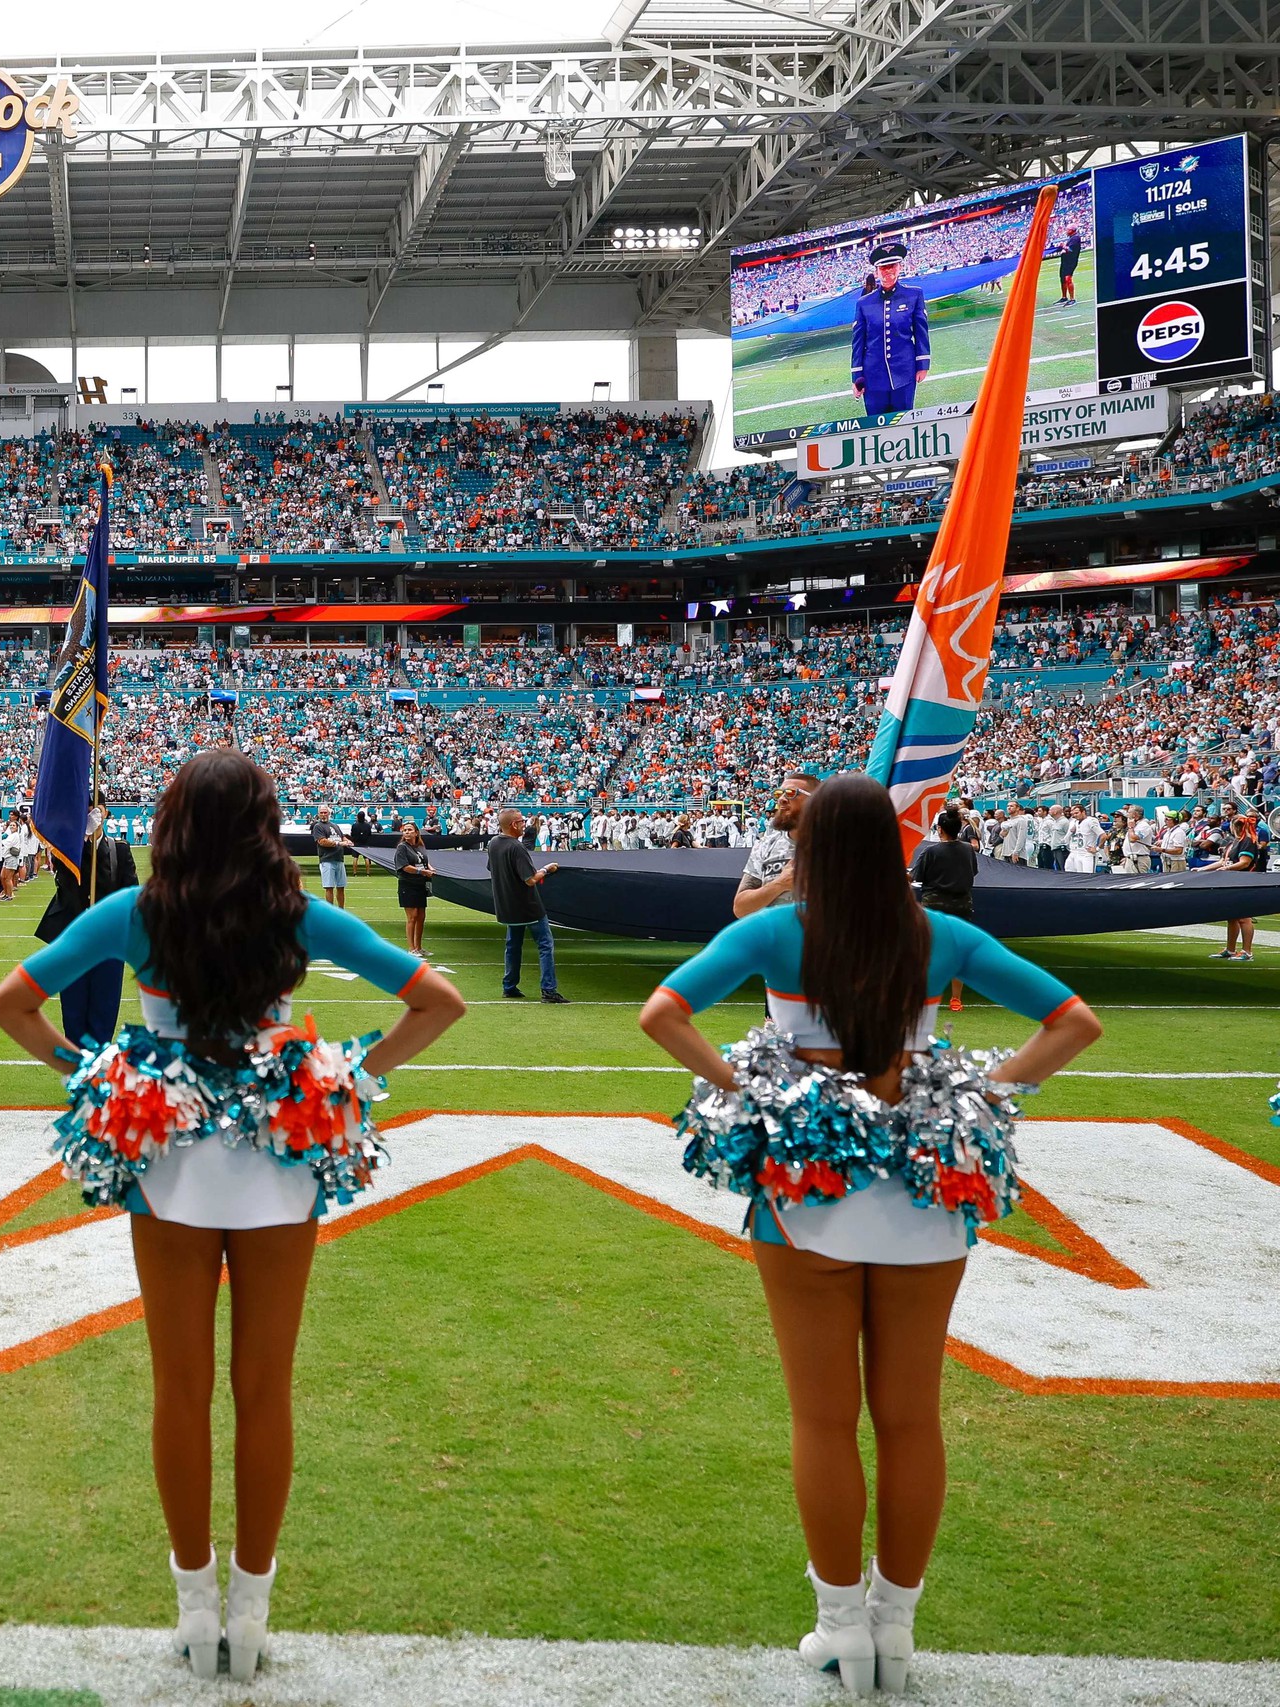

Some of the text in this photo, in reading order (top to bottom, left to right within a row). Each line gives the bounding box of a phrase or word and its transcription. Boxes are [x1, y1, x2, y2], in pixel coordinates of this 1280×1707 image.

[1145, 179, 1192, 203] 11.17.24
[1175, 198, 1208, 213] SOLIS
[1130, 242, 1210, 280] 4:45
[1141, 319, 1201, 343] PEPSI
[1131, 374, 1157, 384] WELCOME
[1131, 381, 1151, 390] UNITED
[294, 409, 311, 418] 334
[593, 407, 610, 415] 336
[1023, 394, 1155, 427] ERSITY OF MIAMI
[751, 433, 766, 444] LV
[789, 428, 797, 439] 0
[836, 419, 861, 432] MIA
[877, 415, 885, 426] 0
[937, 405, 959, 416] 4:44
[1044, 420, 1107, 442] SYSTEM
[1036, 459, 1090, 473] BUD LIGHT
[886, 478, 934, 492] BUD LIGHT
[3, 556, 14, 565] 13
[138, 555, 216, 563] MARK DUPER 85
